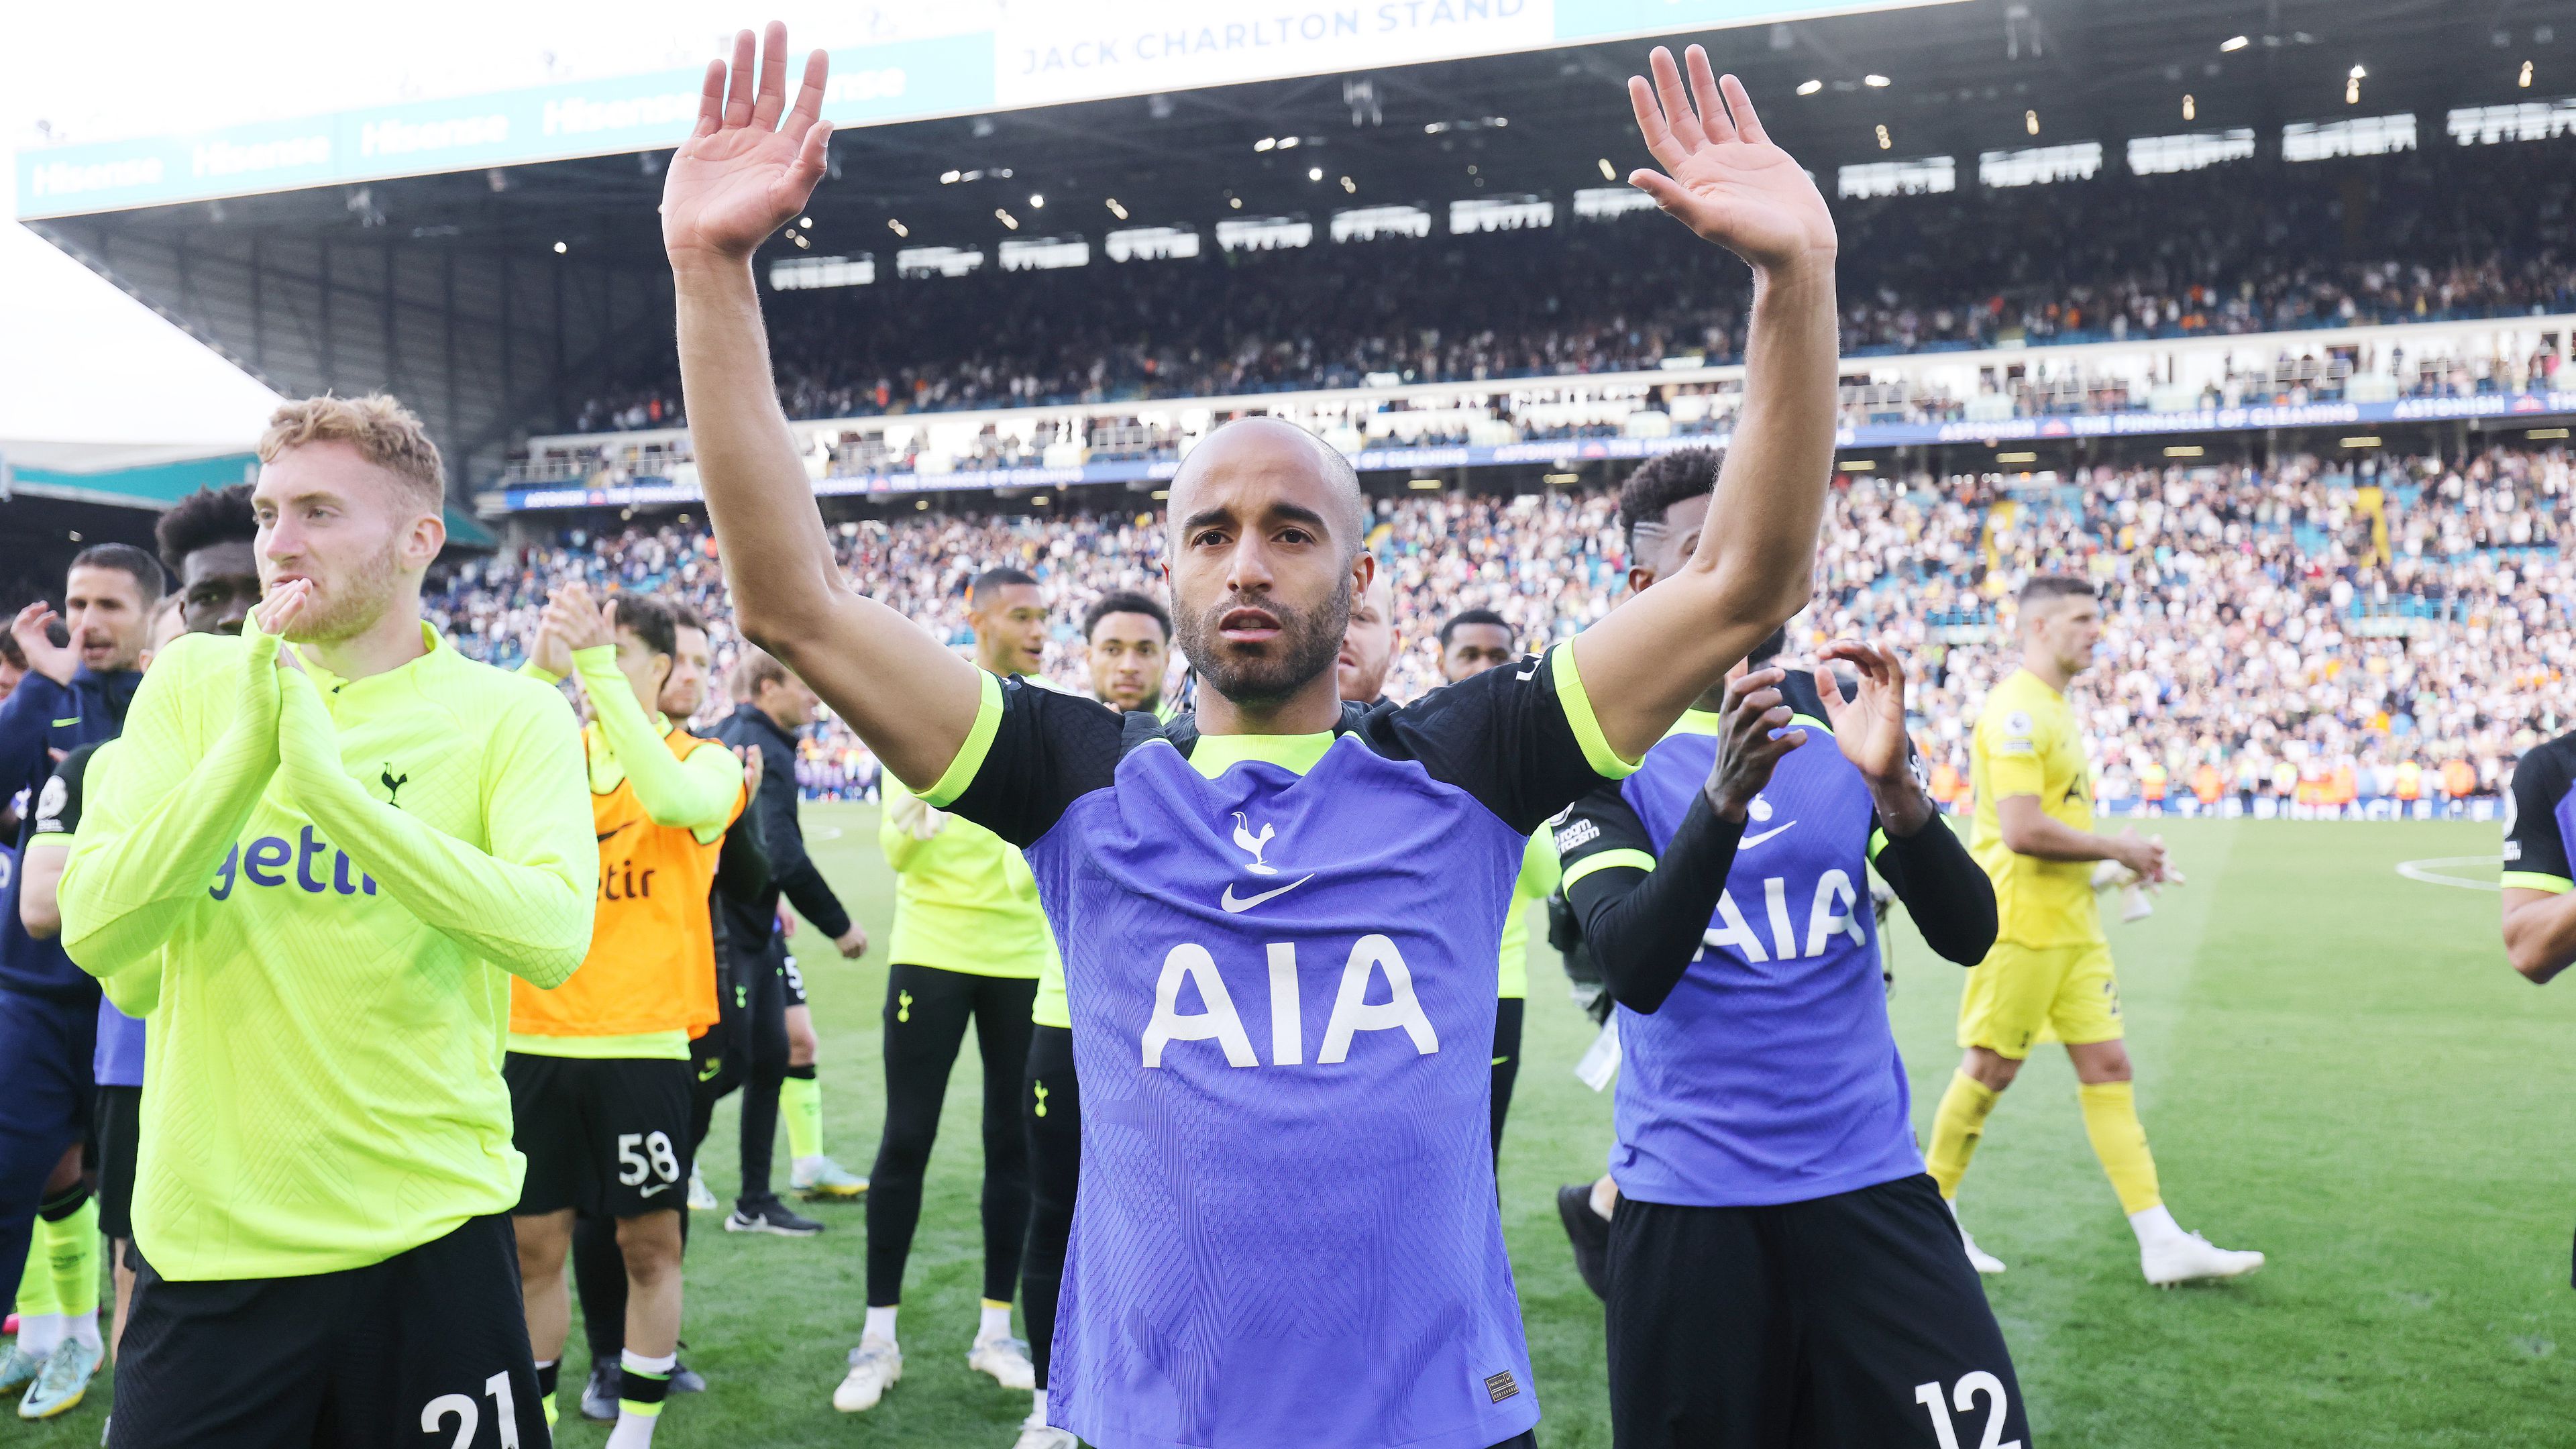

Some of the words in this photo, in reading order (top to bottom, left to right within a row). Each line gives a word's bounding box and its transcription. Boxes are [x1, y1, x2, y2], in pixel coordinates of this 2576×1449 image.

[1022, 38, 1121, 74] JACK
[1136, 9, 1359, 60] CHARLTON
[1378, 0, 1525, 32] STAND
[193, 136, 331, 178] Hisense
[361, 114, 509, 156] Hisense
[32, 157, 163, 198] Hisense
[1560, 818, 1592, 843] room
[1560, 826, 1601, 853] racism
[1692, 868, 1866, 963] AIA
[1142, 933, 1439, 1068] AIA
[618, 1130, 680, 1186] 58
[421, 1370, 520, 1449] 21
[1915, 1370, 2023, 1449] 12
